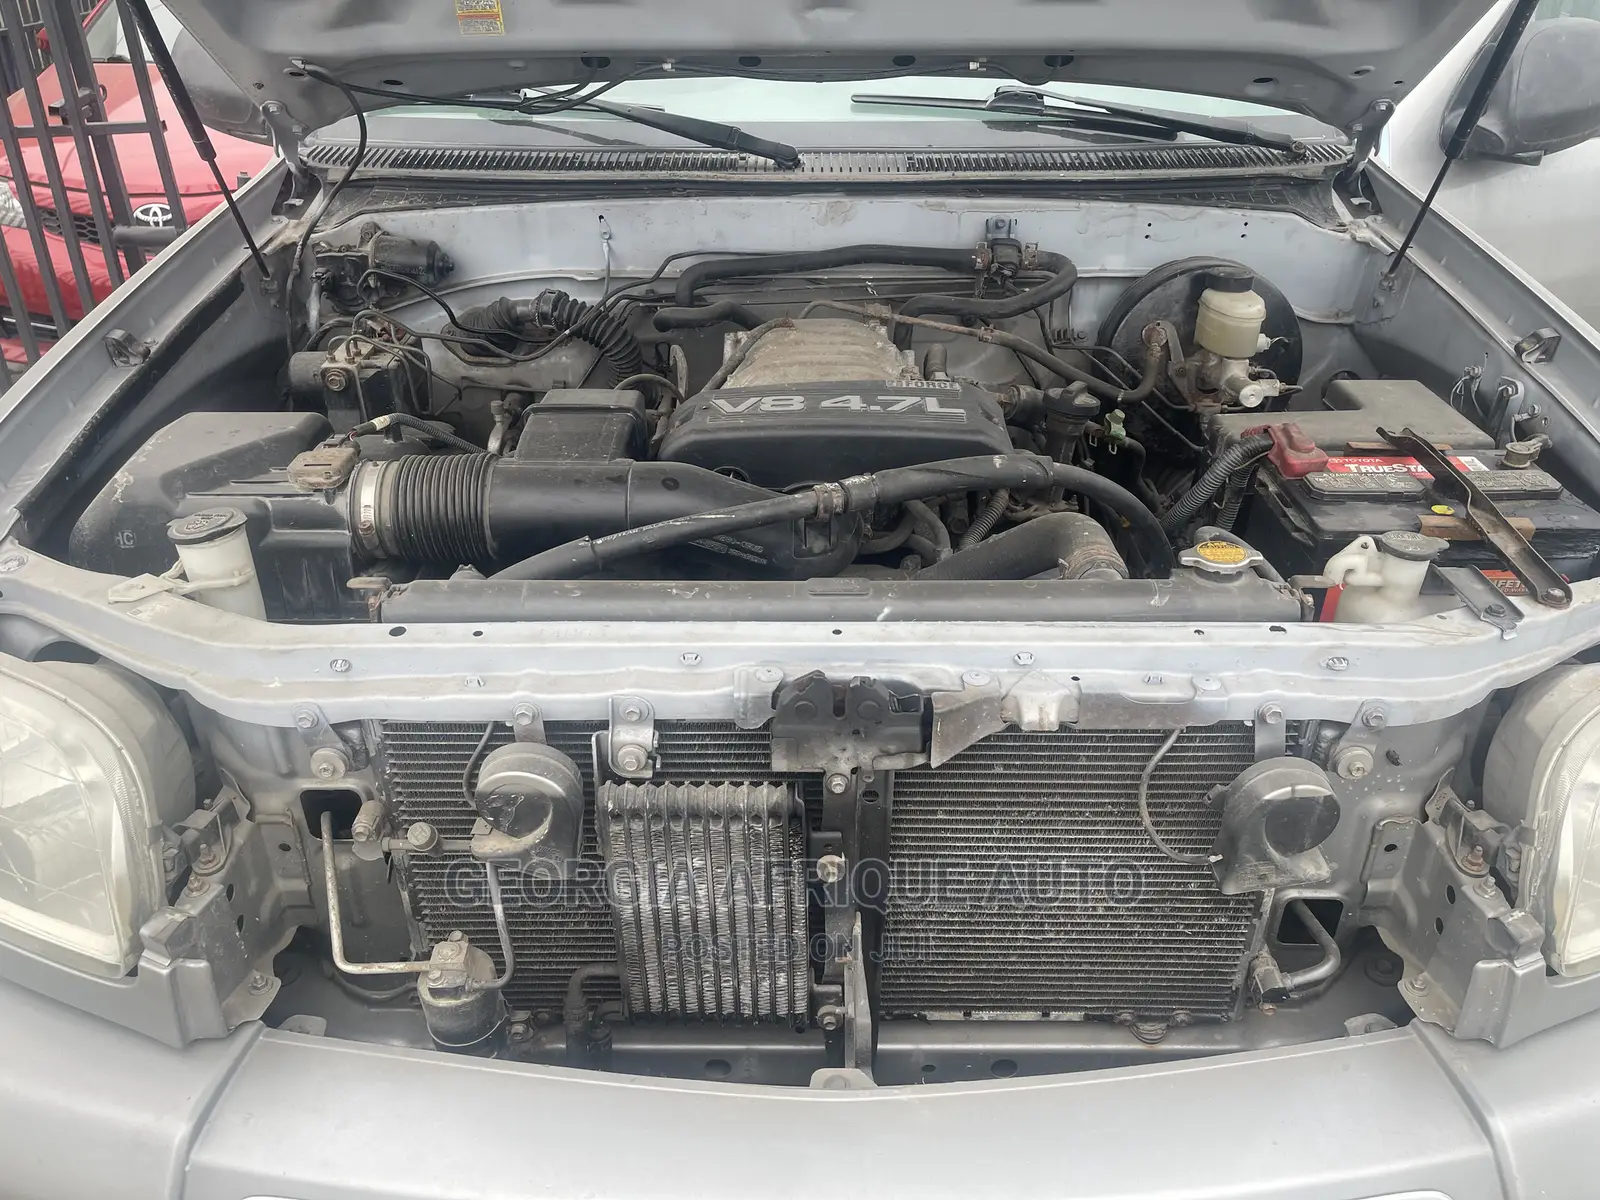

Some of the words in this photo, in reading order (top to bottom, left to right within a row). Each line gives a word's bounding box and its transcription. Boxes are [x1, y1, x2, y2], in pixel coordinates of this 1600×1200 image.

[709, 395, 806, 414] V8
[820, 395, 967, 415] 4.7L
[1344, 463, 1429, 474] TRUESTA
